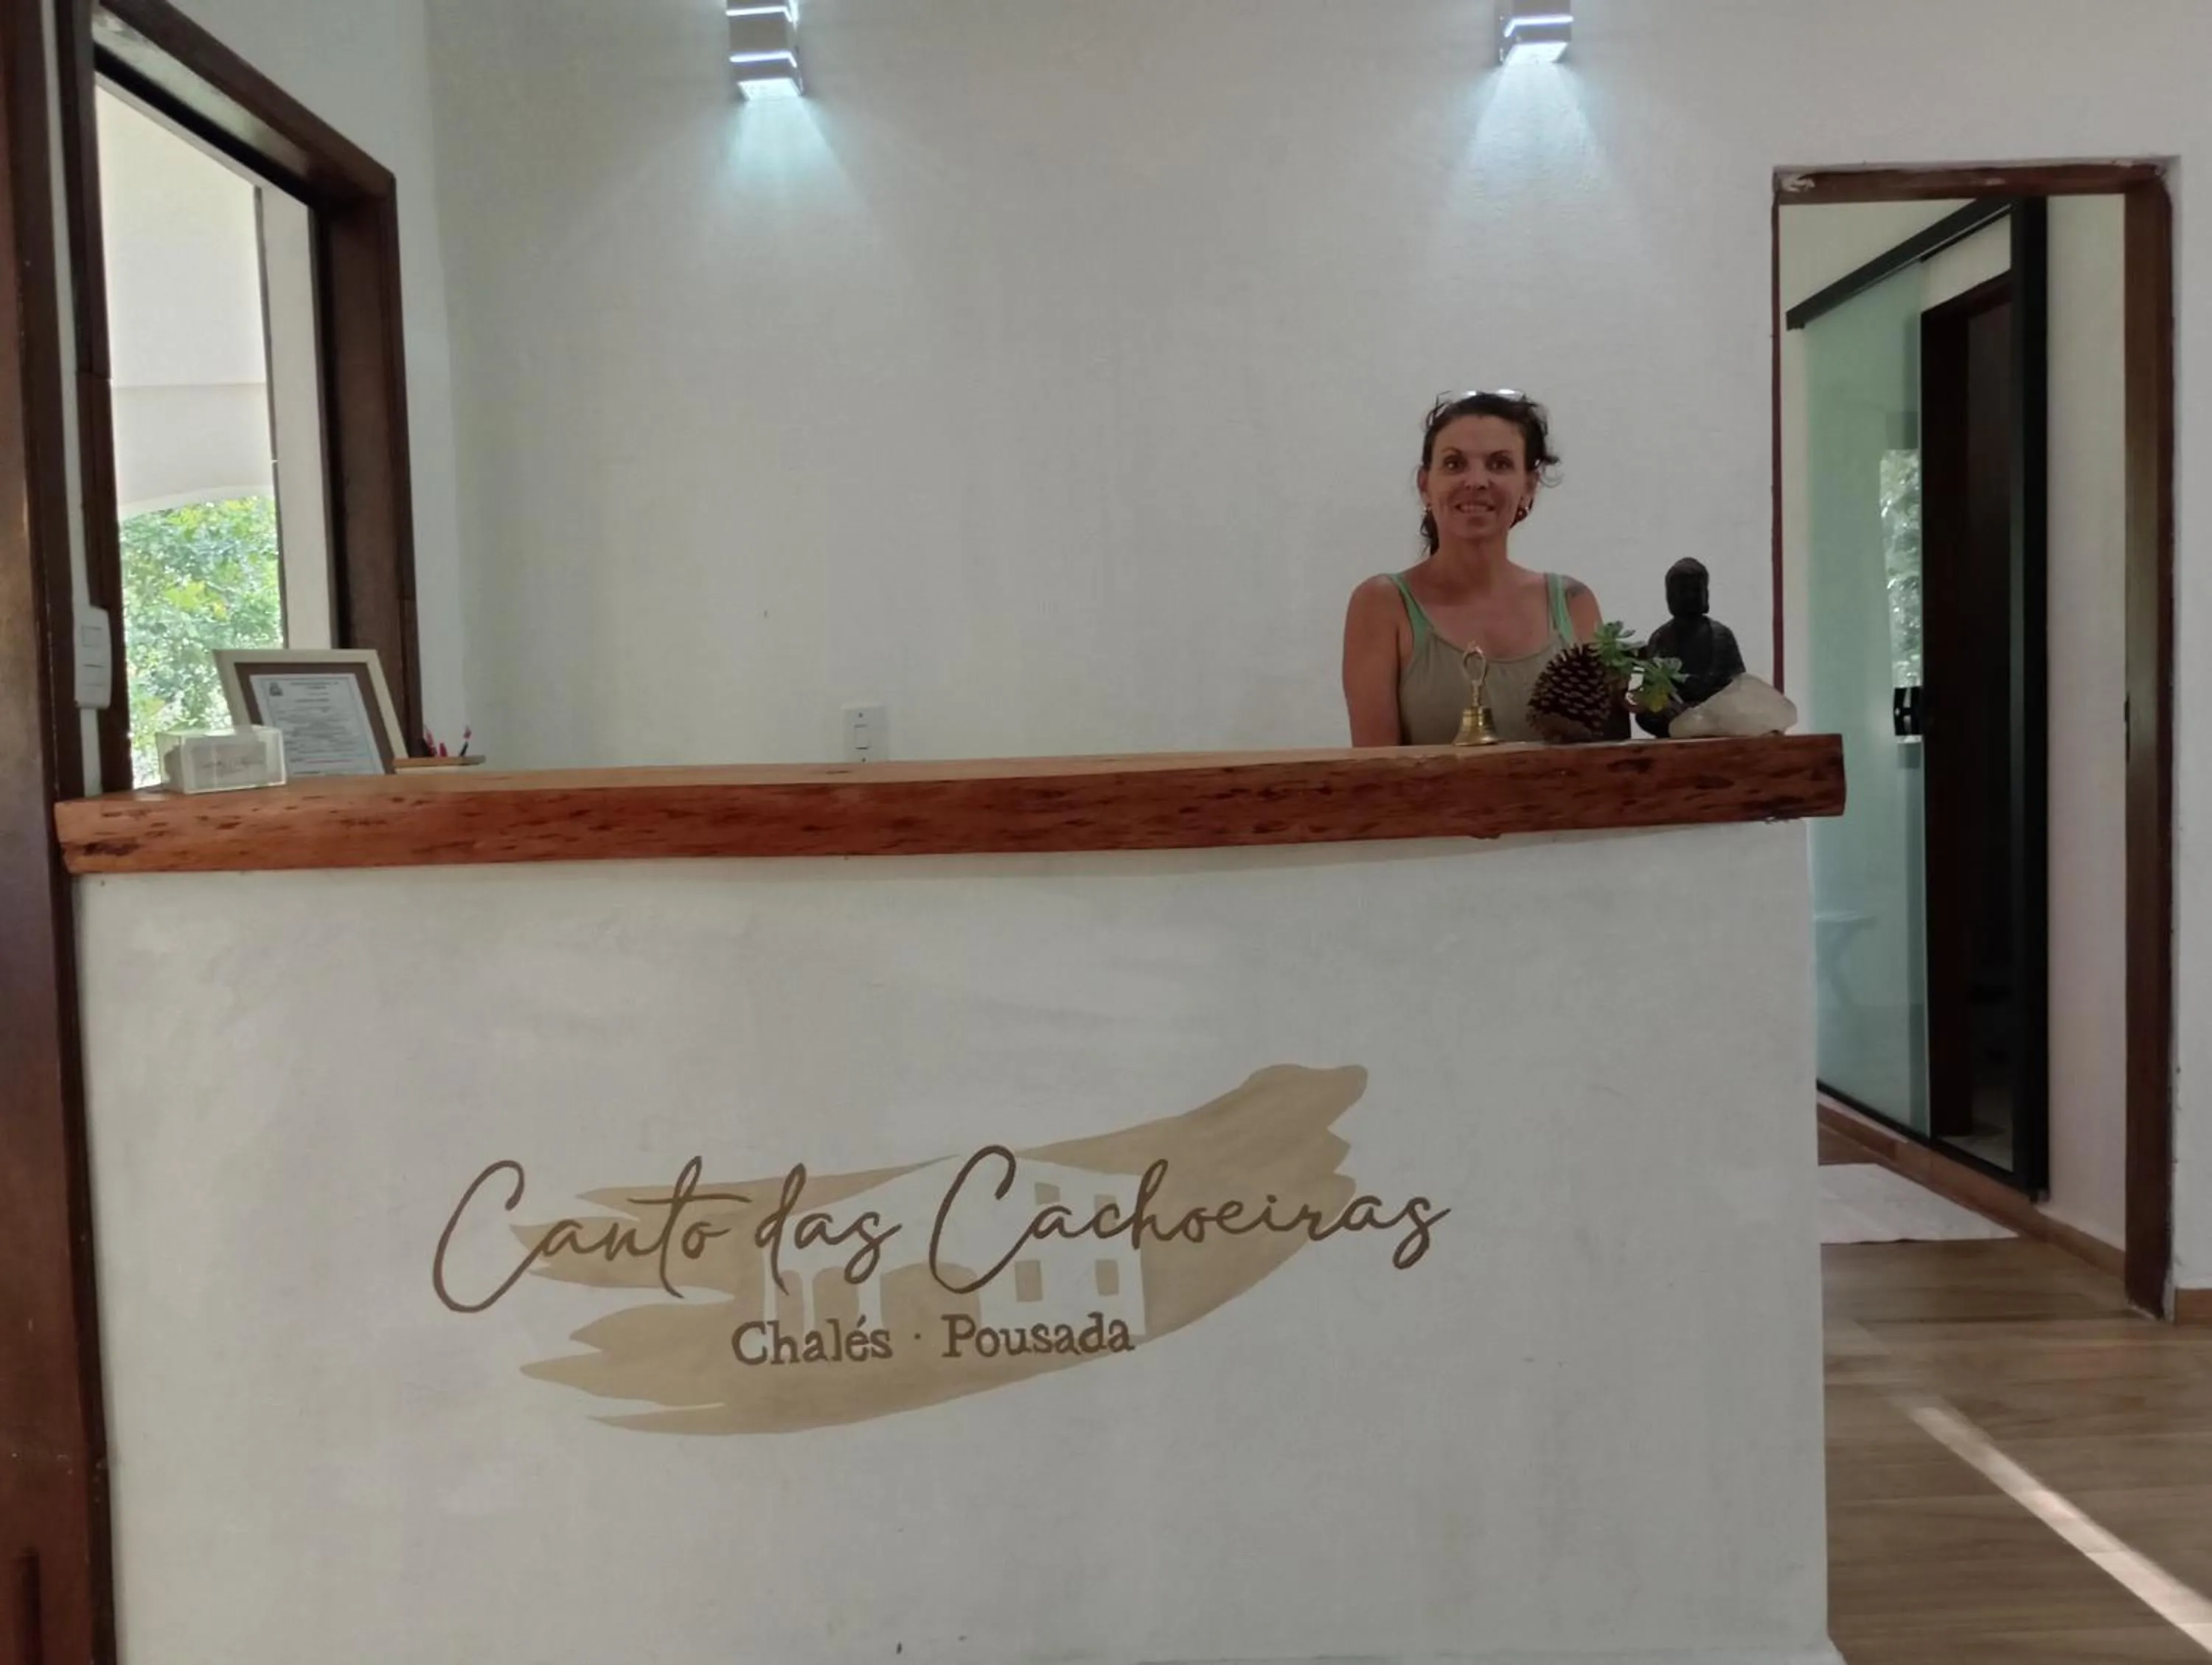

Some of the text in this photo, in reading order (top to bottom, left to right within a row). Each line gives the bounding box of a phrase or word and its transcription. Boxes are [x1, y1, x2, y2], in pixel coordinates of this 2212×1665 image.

[433, 1144, 1450, 1313] Canto das Cachoeiras
[731, 1312, 1135, 1366] Chalés Pousada
